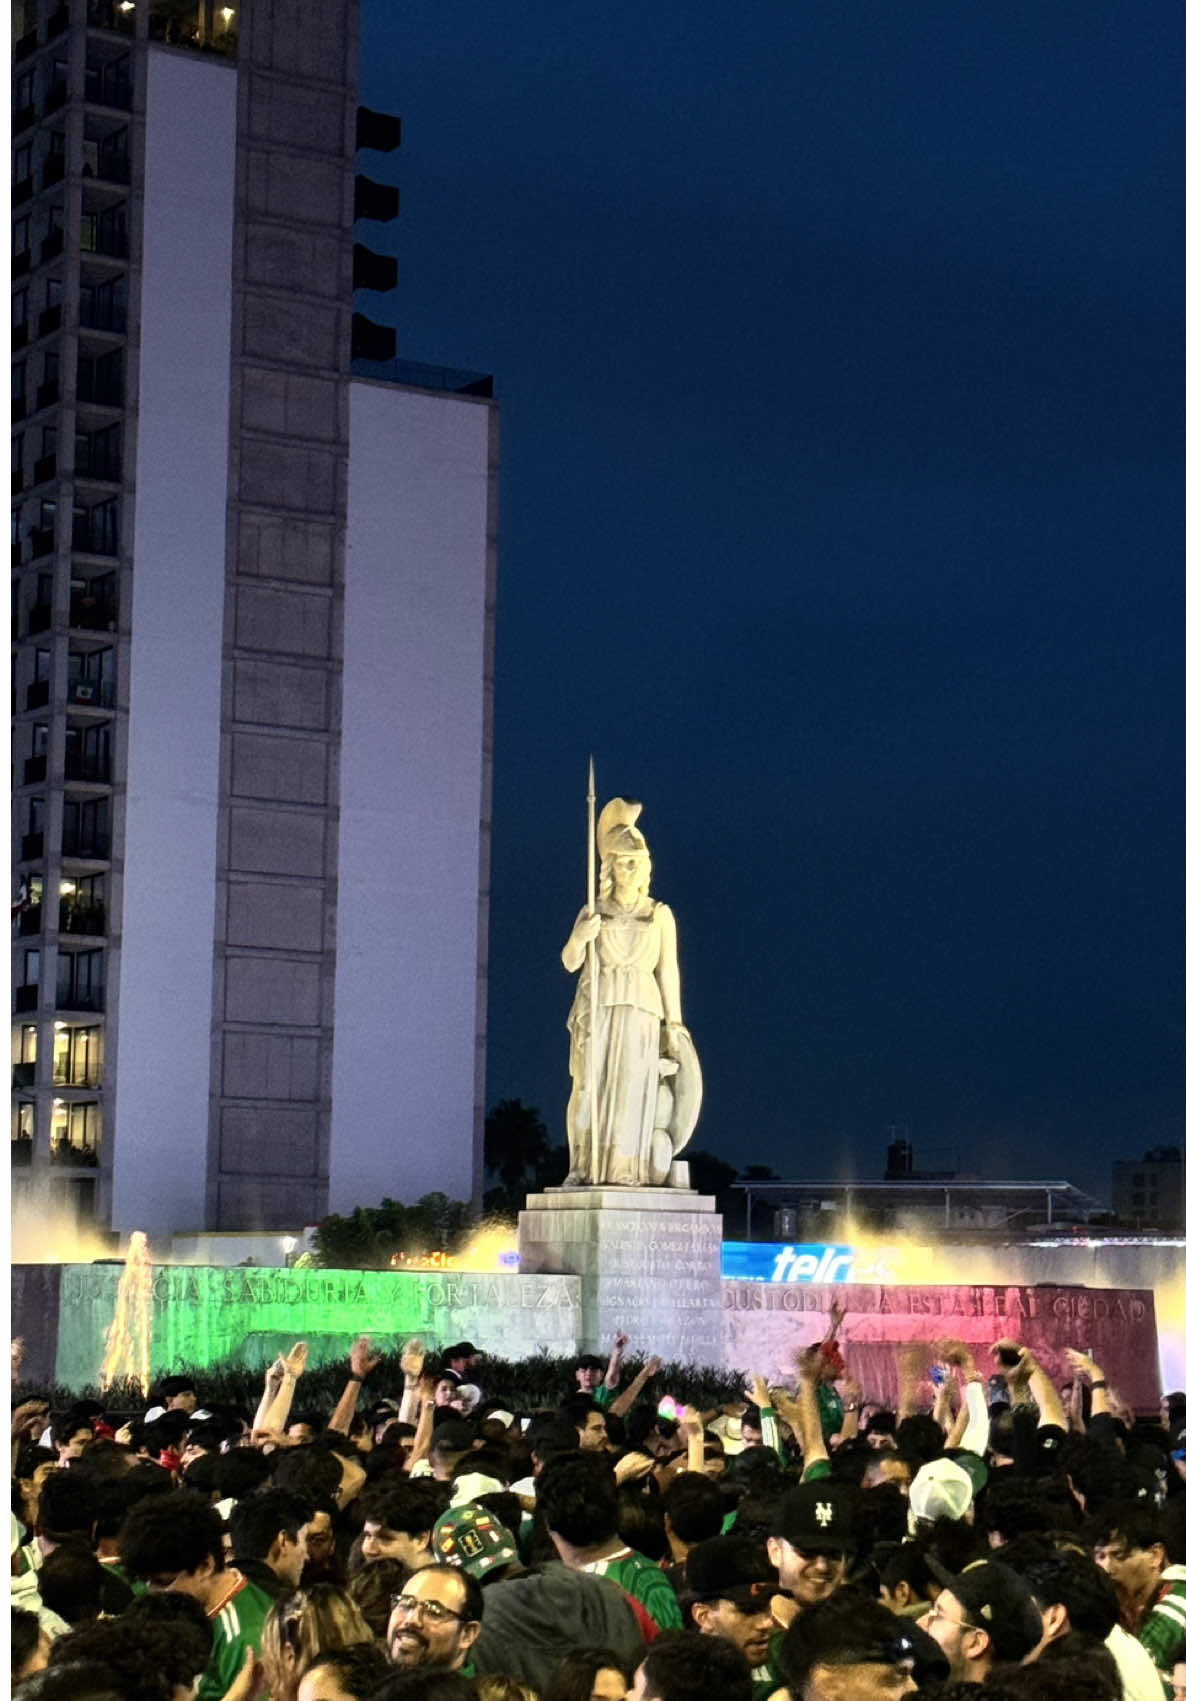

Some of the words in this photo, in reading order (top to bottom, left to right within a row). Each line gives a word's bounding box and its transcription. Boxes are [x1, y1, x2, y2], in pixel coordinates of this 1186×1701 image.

[772, 1246, 894, 1283] telc
[222, 1278, 368, 1305] SABIDURIA
[722, 1287, 874, 1314] CUSTODI
